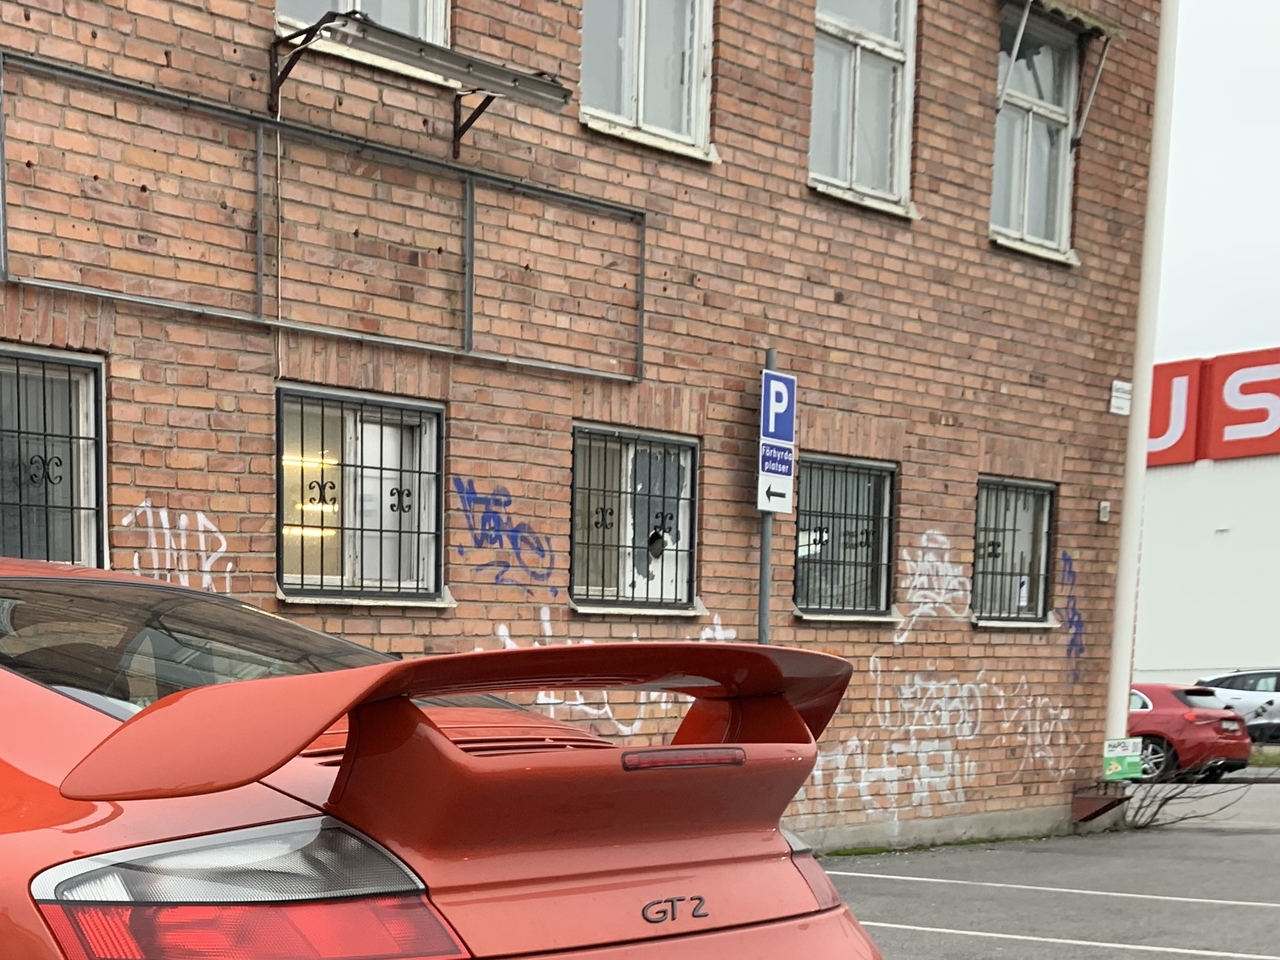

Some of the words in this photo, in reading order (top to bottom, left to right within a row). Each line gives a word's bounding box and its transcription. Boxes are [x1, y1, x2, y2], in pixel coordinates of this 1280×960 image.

[769, 380, 789, 432] P
[762, 446, 793, 461] Förhyrda
[764, 460, 789, 473] platser
